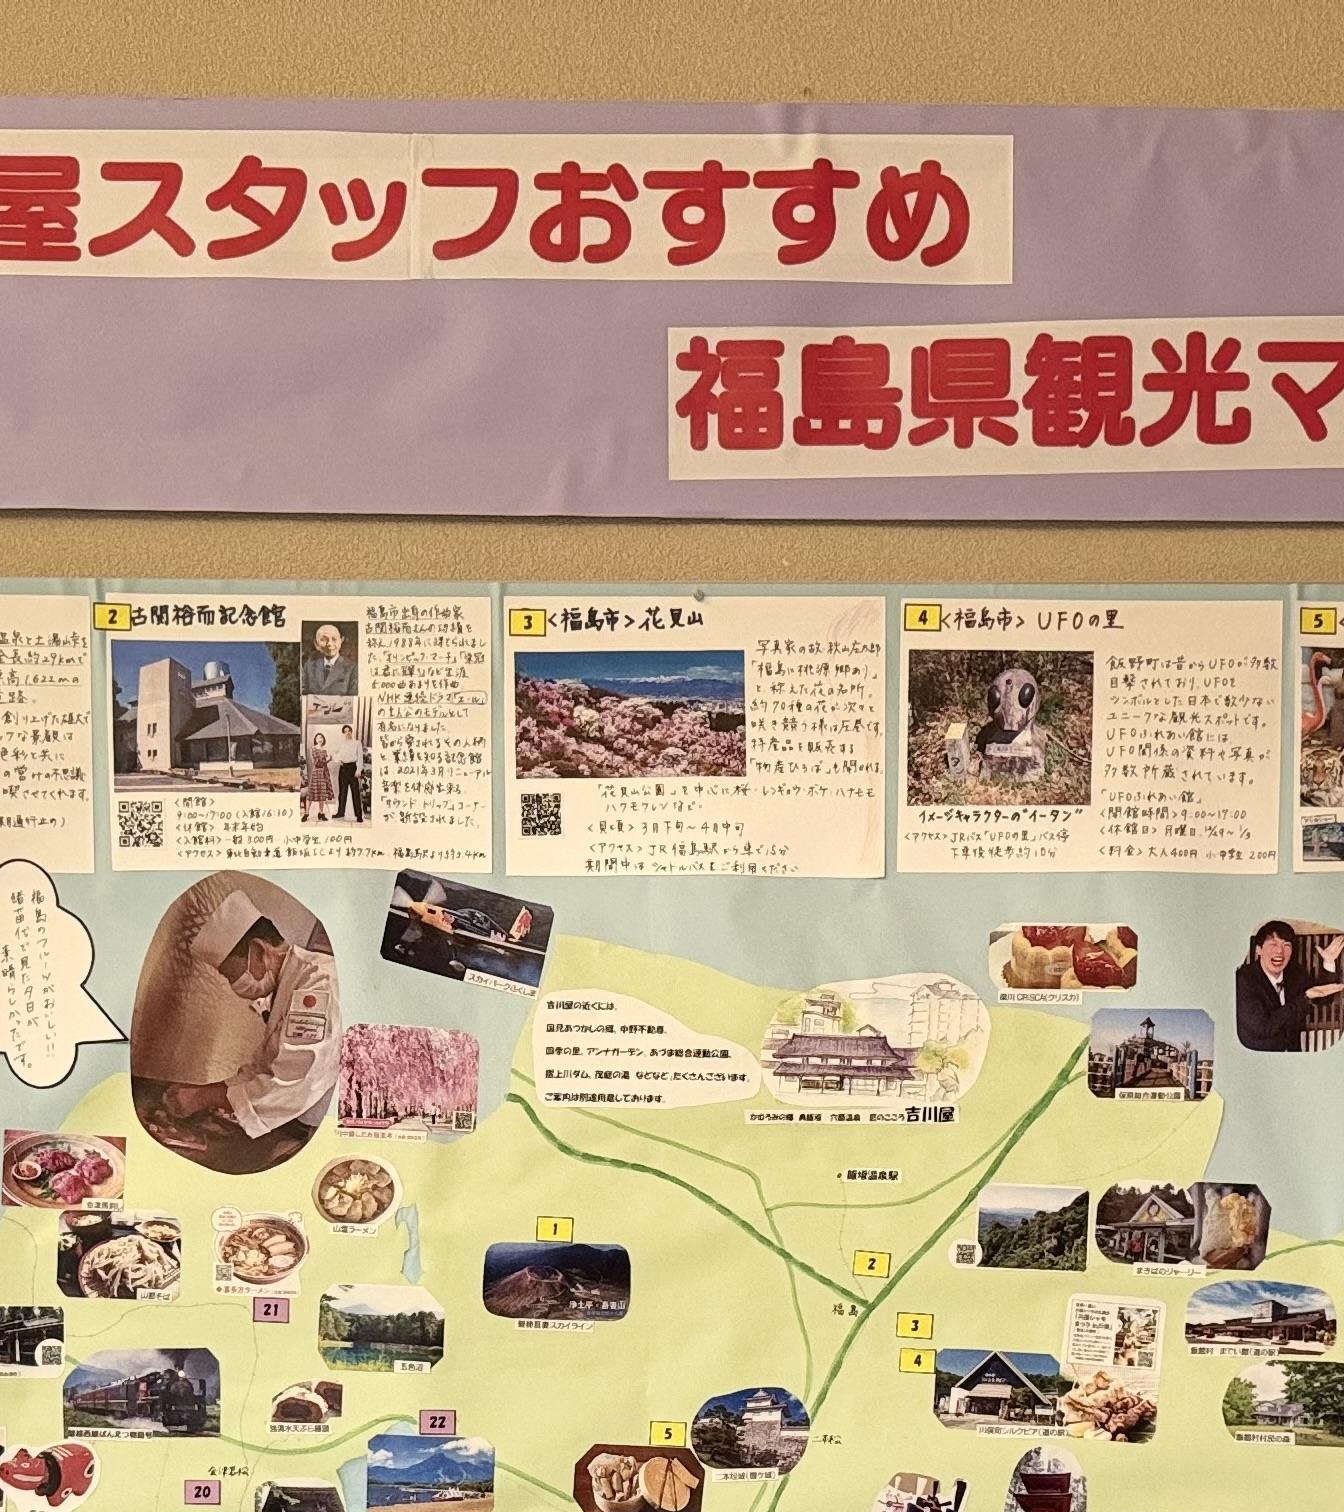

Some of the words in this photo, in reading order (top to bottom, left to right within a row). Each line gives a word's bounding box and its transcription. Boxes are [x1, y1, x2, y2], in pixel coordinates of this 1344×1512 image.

[108, 608, 118, 625] 2
[523, 615, 533, 630] 3
[918, 609, 929, 625] 4
[1037, 609, 1125, 631] UFOの里
[1313, 613, 1324, 629] 5
[903, 1104, 957, 1124] 吉川屋
[553, 1222, 558, 1236] 1
[867, 1257, 877, 1271] 2
[263, 1303, 279, 1317] 21
[911, 1319, 920, 1332] 3
[913, 1354, 922, 1367] 4
[429, 1415, 447, 1429] 22
[664, 1427, 673, 1440] 5
[194, 1485, 211, 1499] 20
